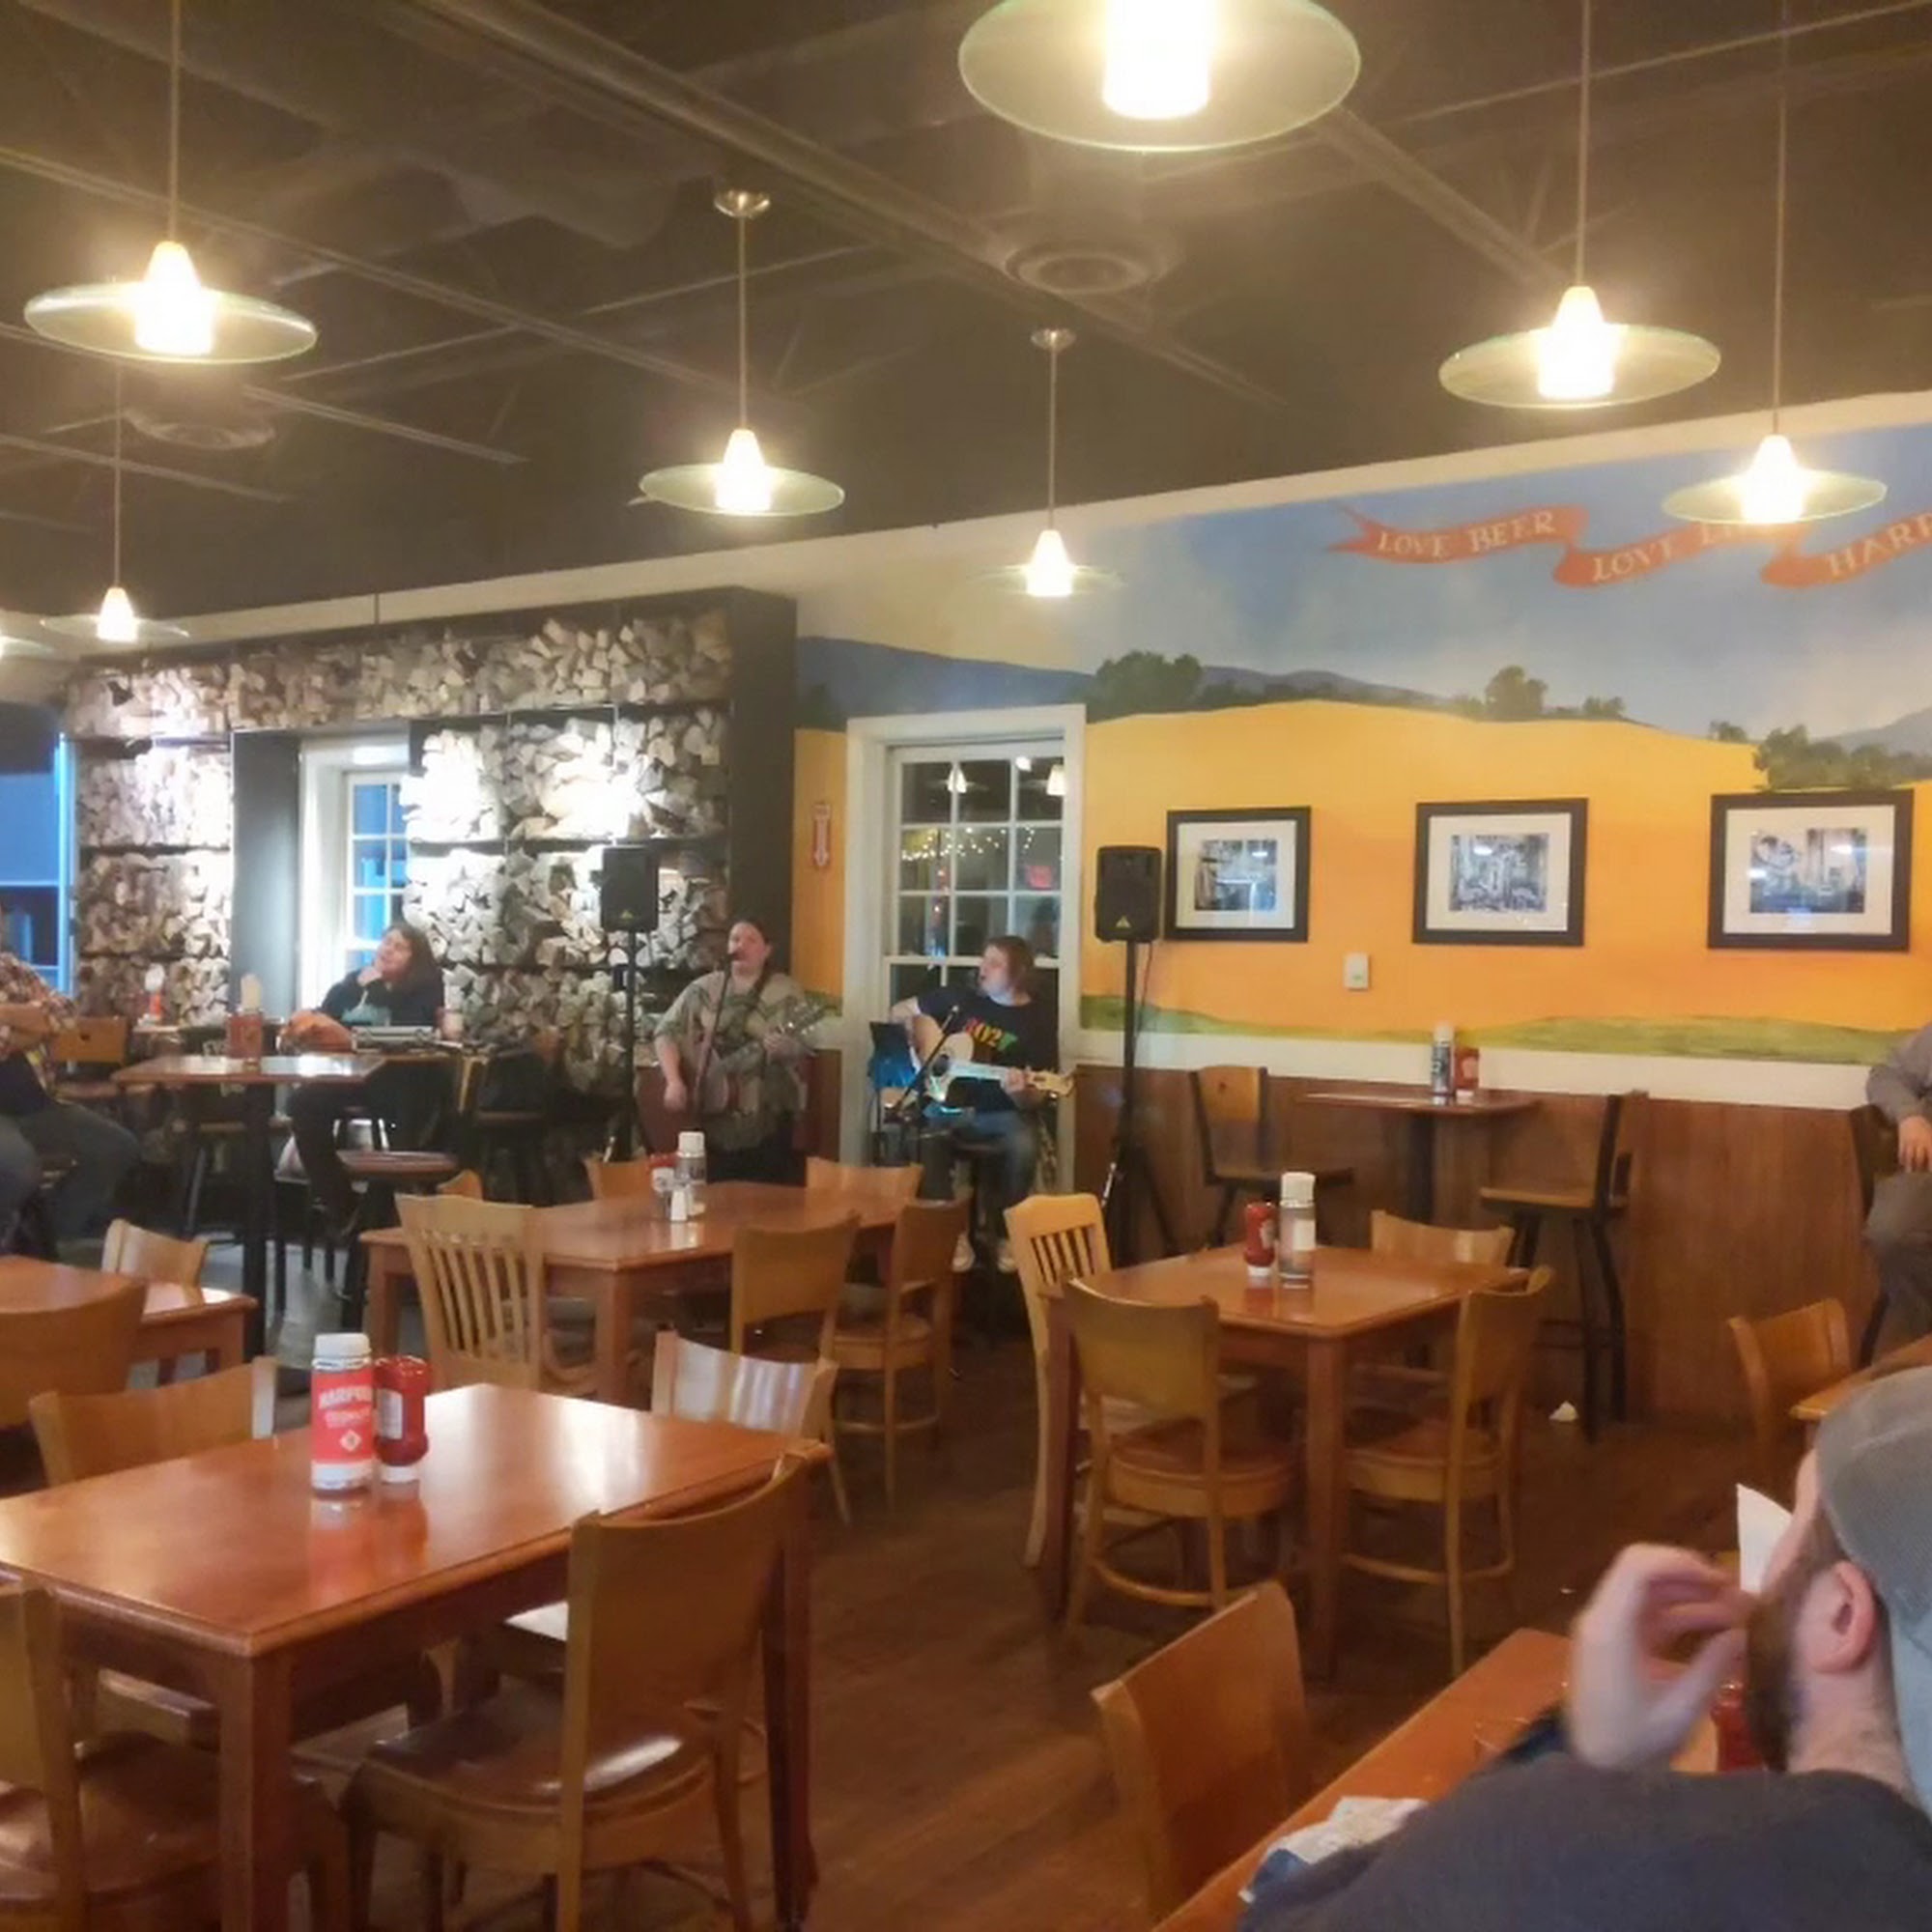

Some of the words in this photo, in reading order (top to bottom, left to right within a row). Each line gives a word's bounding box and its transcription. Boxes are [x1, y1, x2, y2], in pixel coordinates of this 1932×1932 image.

[1378, 531, 1448, 558] LOVE
[1467, 510, 1556, 554] BEER
[1591, 535, 1678, 582] LOVE
